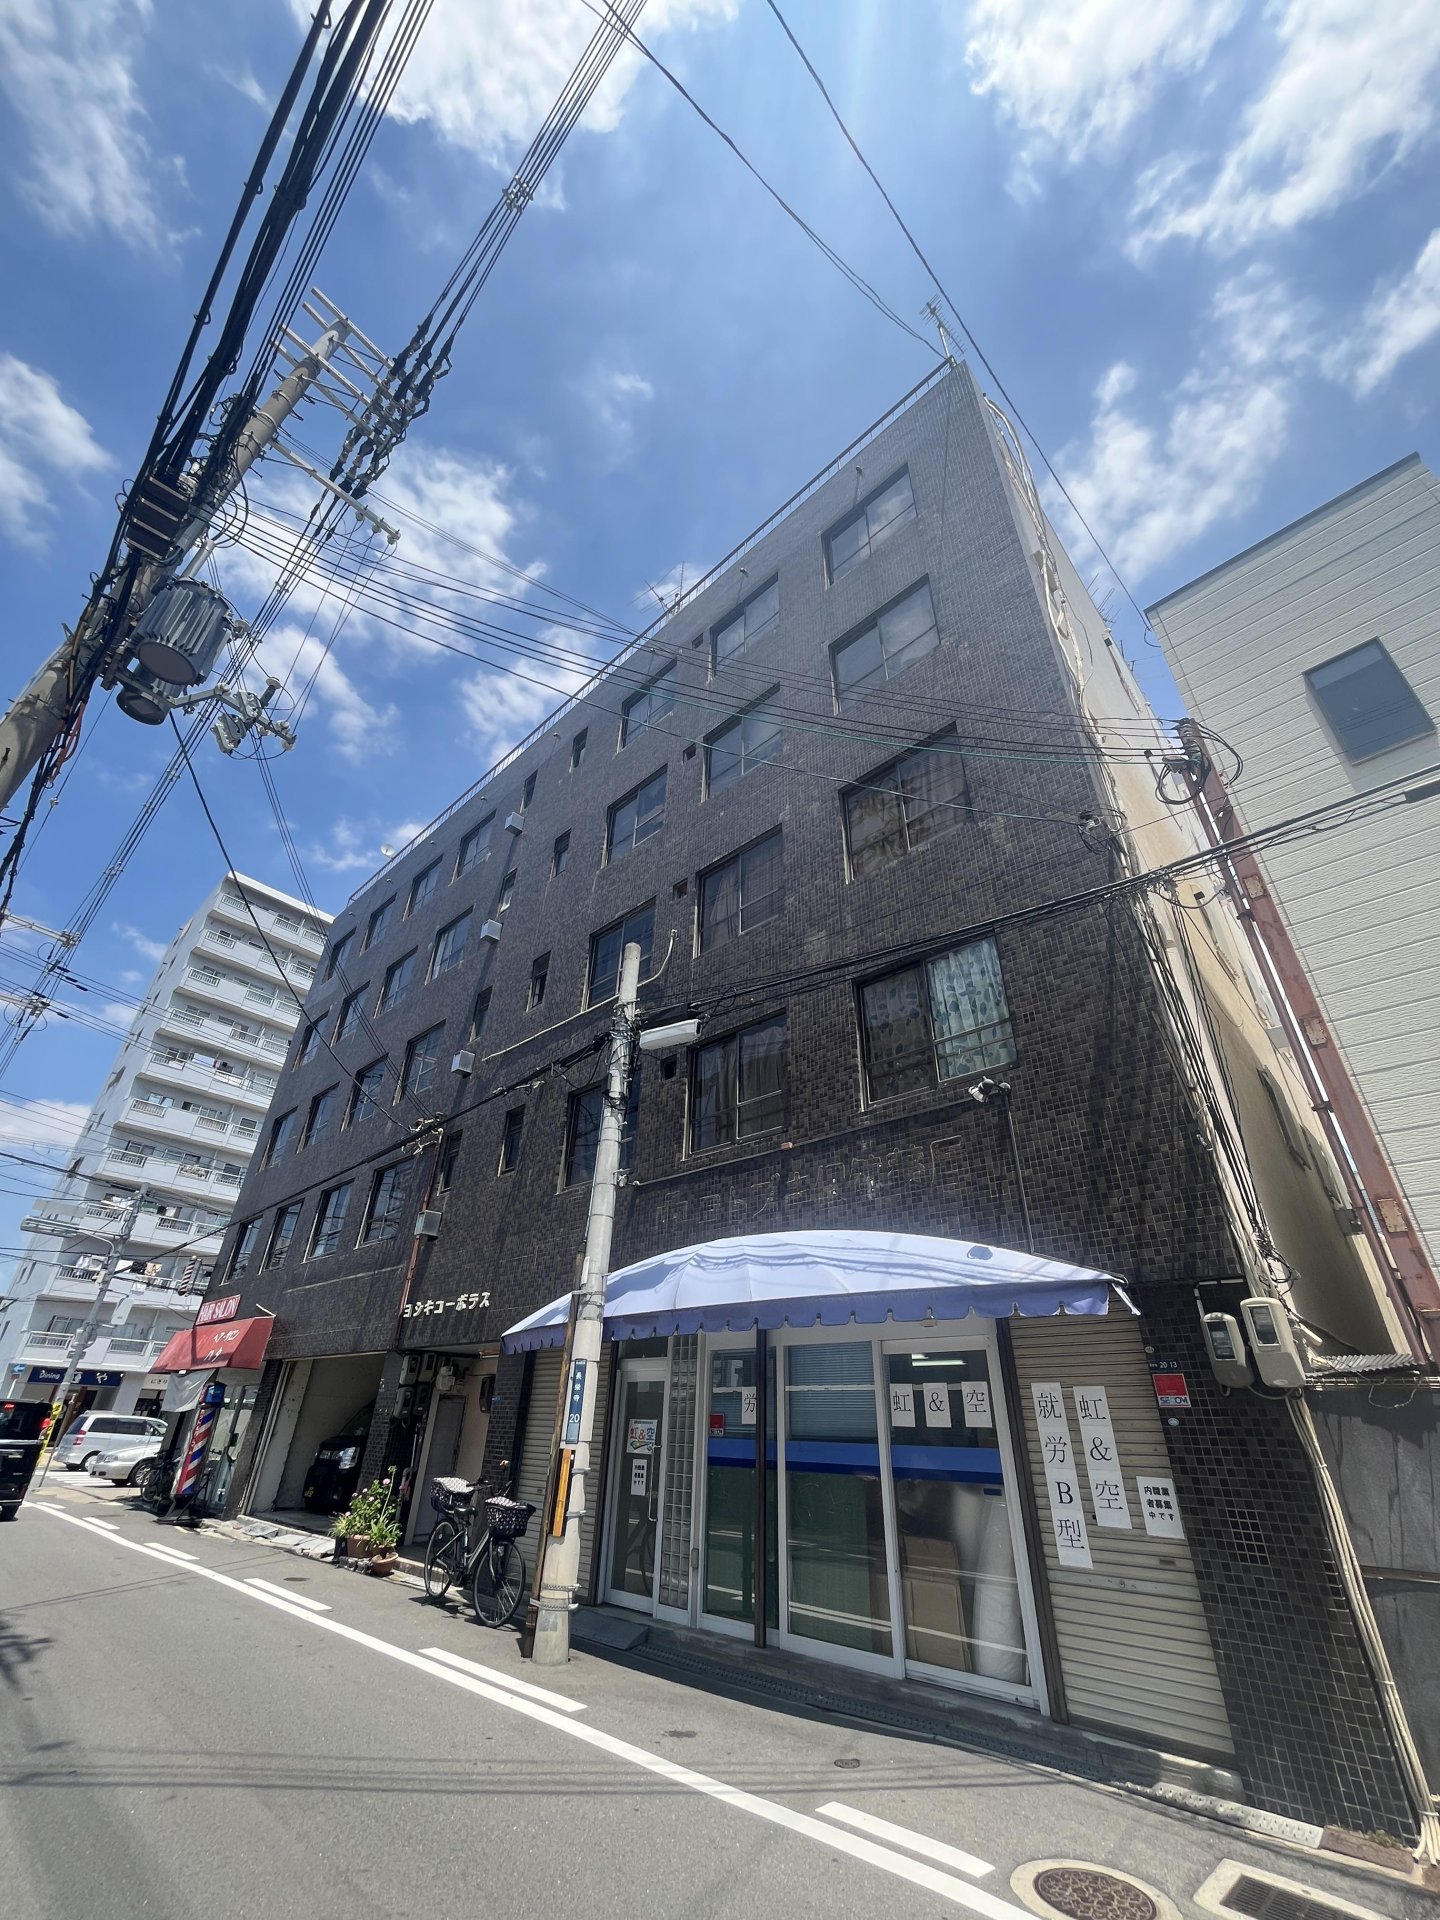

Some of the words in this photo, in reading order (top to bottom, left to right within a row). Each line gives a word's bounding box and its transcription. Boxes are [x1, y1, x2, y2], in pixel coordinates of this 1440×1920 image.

[39, 1370, 60, 1380] Dining
[744, 1393, 756, 1413] 労
[569, 1413, 580, 1423] 20
[1079, 1395, 1124, 1510] 虹&空
[1037, 1393, 1086, 1549] 就労B型
[1148, 1511, 1175, 1521] 中です
